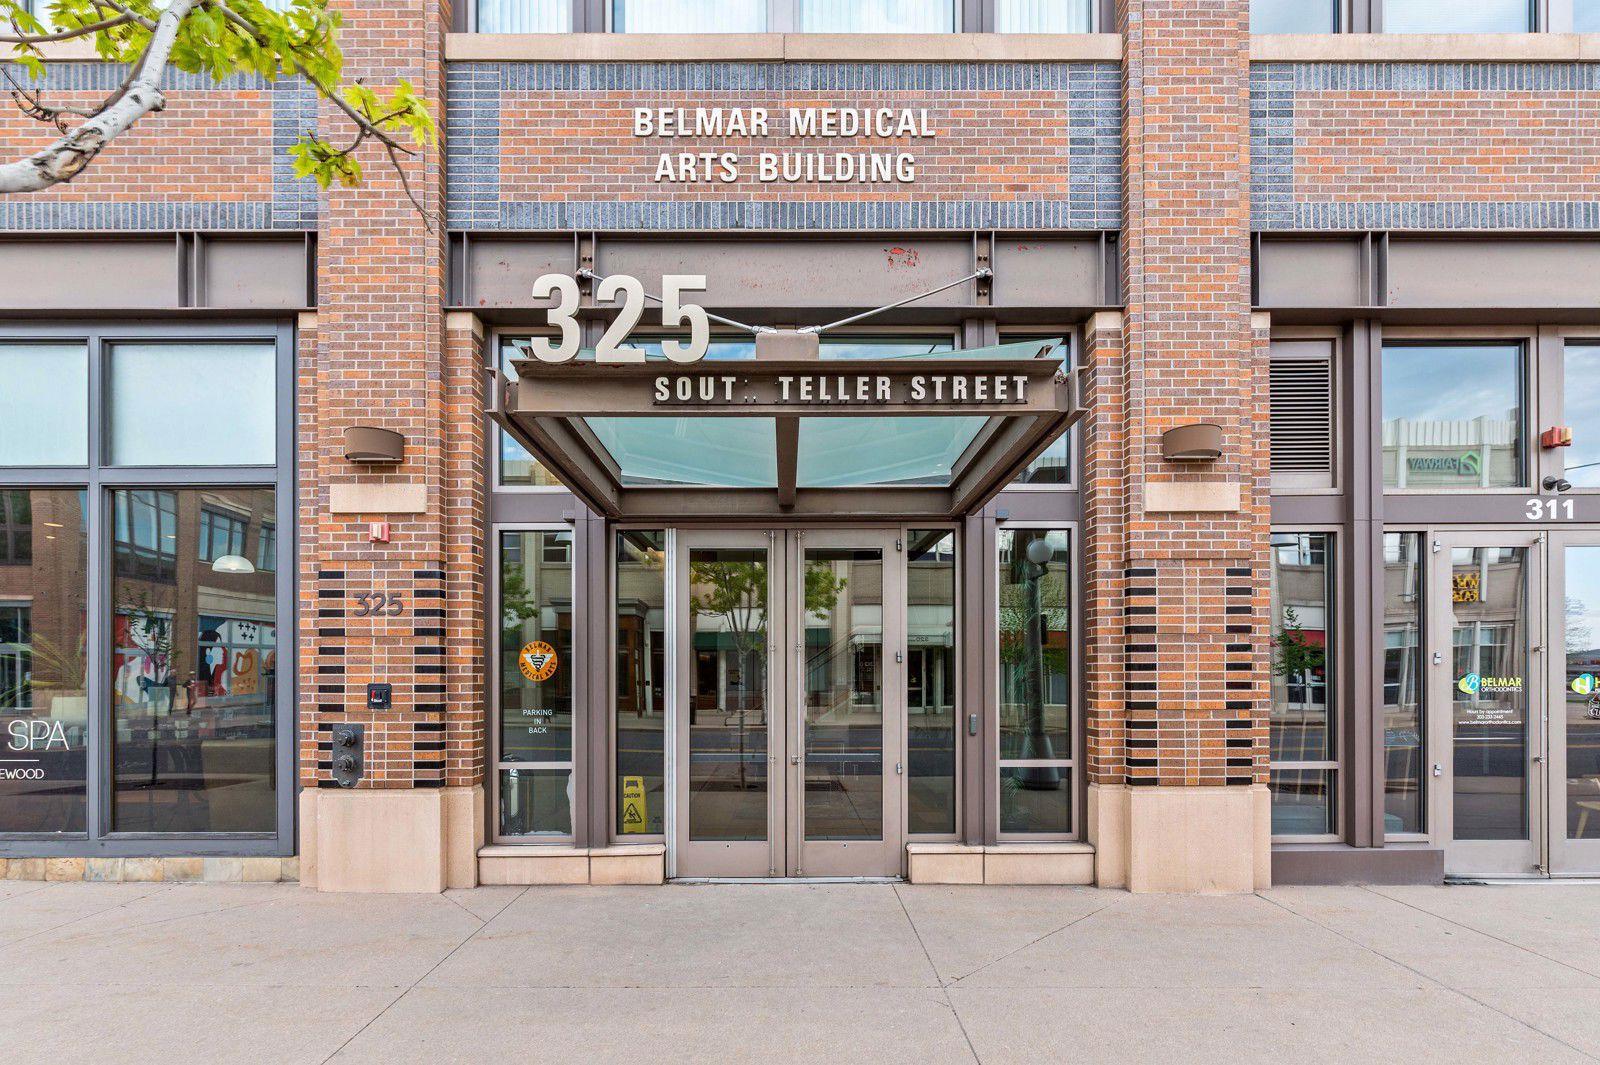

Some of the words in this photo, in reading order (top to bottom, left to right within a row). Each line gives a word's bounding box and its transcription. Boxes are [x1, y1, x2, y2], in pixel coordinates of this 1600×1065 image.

[634, 107, 768, 137] BELMAR
[789, 107, 936, 138] MEDICAL
[654, 152, 739, 183] ARTS
[759, 152, 915, 183] BUILDING
[530, 273, 710, 364] 325
[778, 376, 892, 401] TELLER
[911, 376, 1028, 401] STREET
[1525, 498, 1574, 520] 311
[353, 592, 404, 617] 325
[524, 641, 552, 653] BELMAR
[520, 662, 544, 680] MEDICAL
[1481, 677, 1522, 687] BELMAR
[7, 720, 70, 751] SPA
